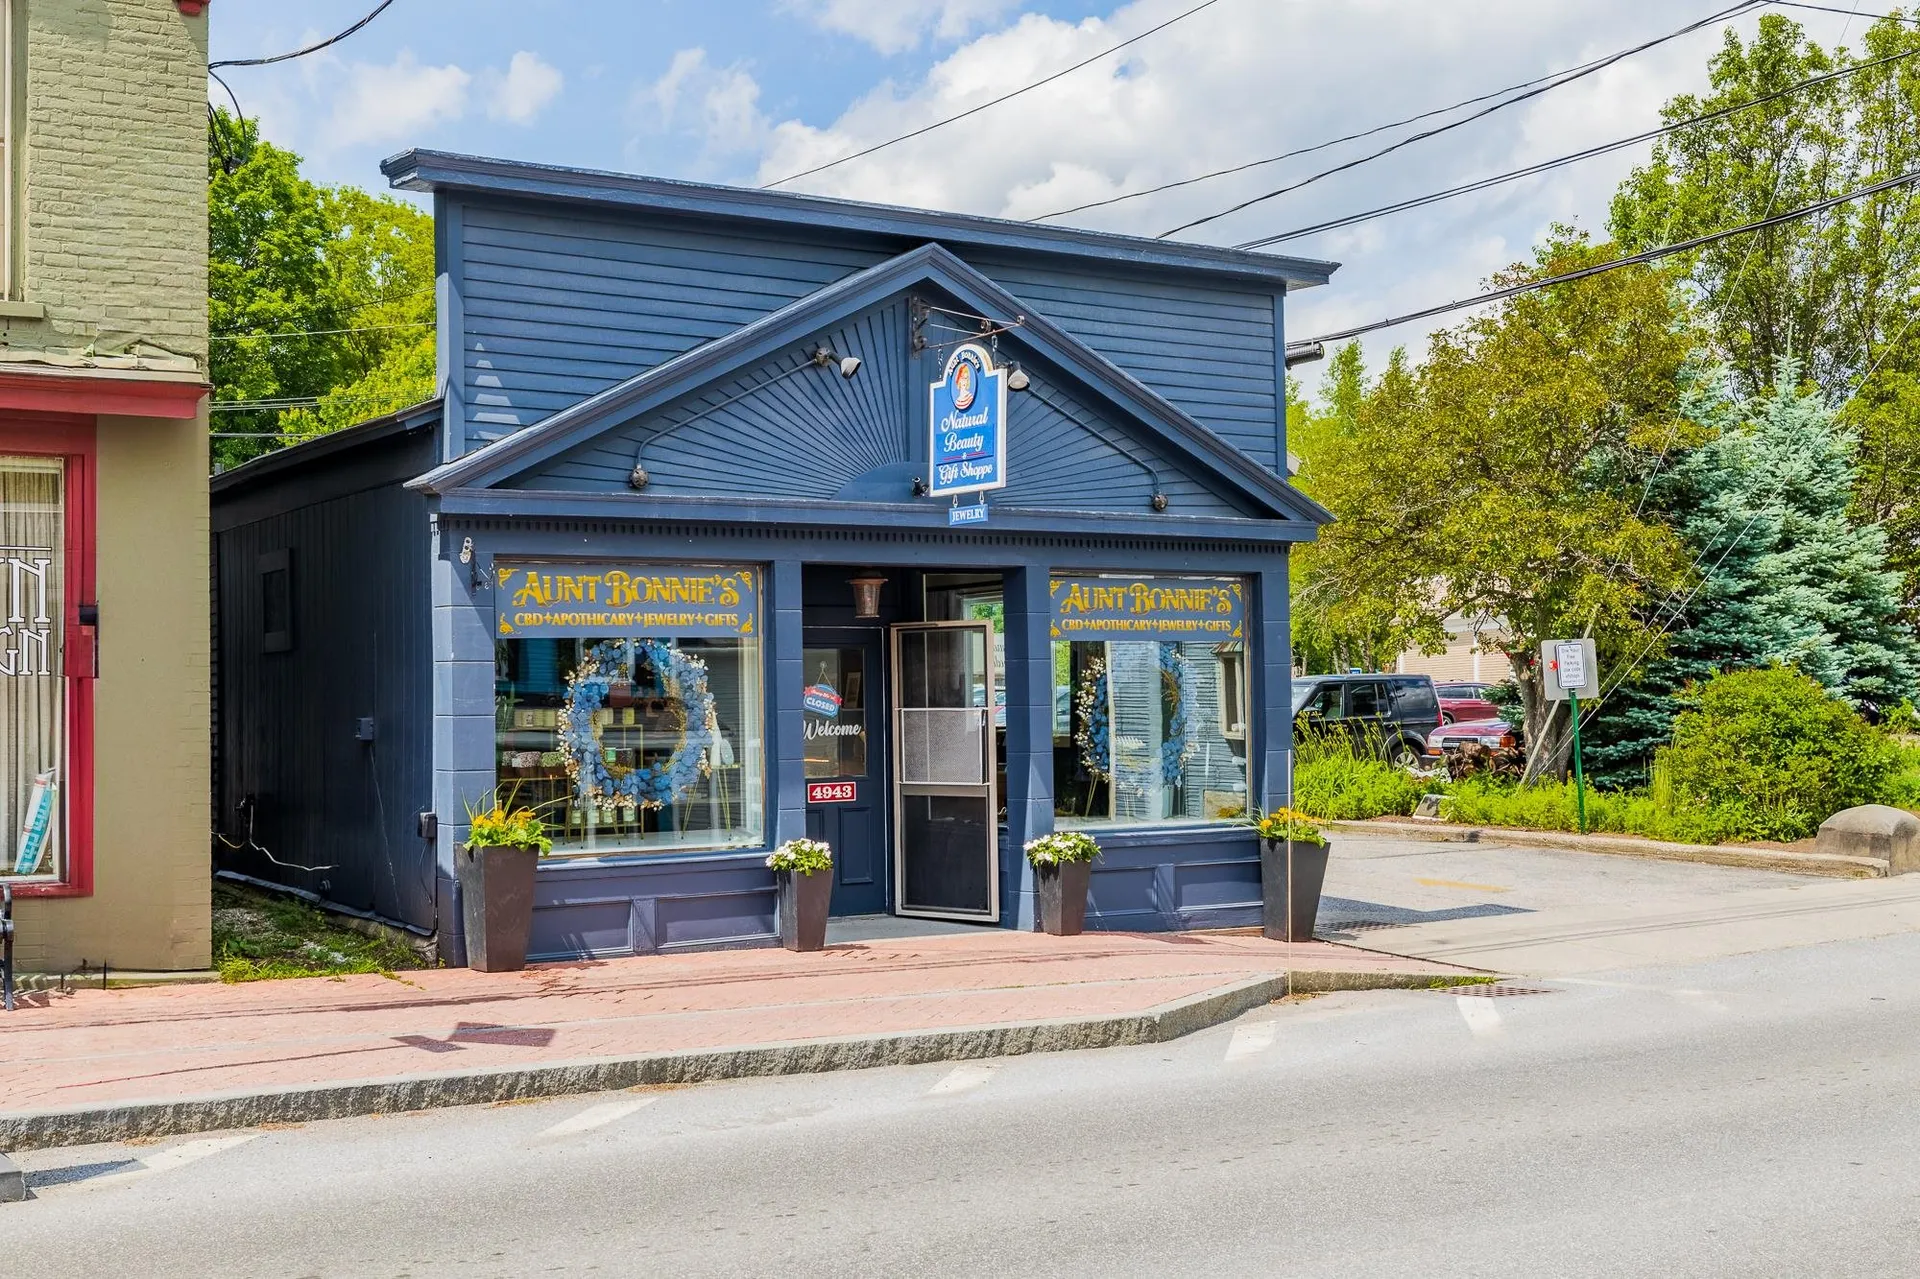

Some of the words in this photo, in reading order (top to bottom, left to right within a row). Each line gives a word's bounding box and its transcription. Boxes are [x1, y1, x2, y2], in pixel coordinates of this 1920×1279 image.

[941, 406, 988, 432] Natural
[944, 432, 984, 452] Beauty
[939, 463, 958, 486] Gift
[960, 461, 993, 480] Shoppe
[952, 508, 985, 522] JEWELRY
[512, 571, 601, 606] AUNT
[604, 570, 740, 607] BONNIE'S
[1060, 583, 1127, 614] AUNT
[1129, 582, 1233, 615] BONNIE'S
[514, 613, 544, 626] CBD
[551, 613, 634, 626] APOTHICARY
[643, 613, 695, 628] JEWELRY
[704, 613, 739, 626] GIFTS
[1061, 619, 1084, 631] CBD
[1089, 619, 1152, 631] APOTHICARY
[1158, 619, 1197, 632] JEWELRY
[1205, 619, 1231, 631] GIFTS
[806, 697, 835, 711] CLOSED
[803, 720, 861, 740] Welcome
[812, 786, 852, 799] 4943
